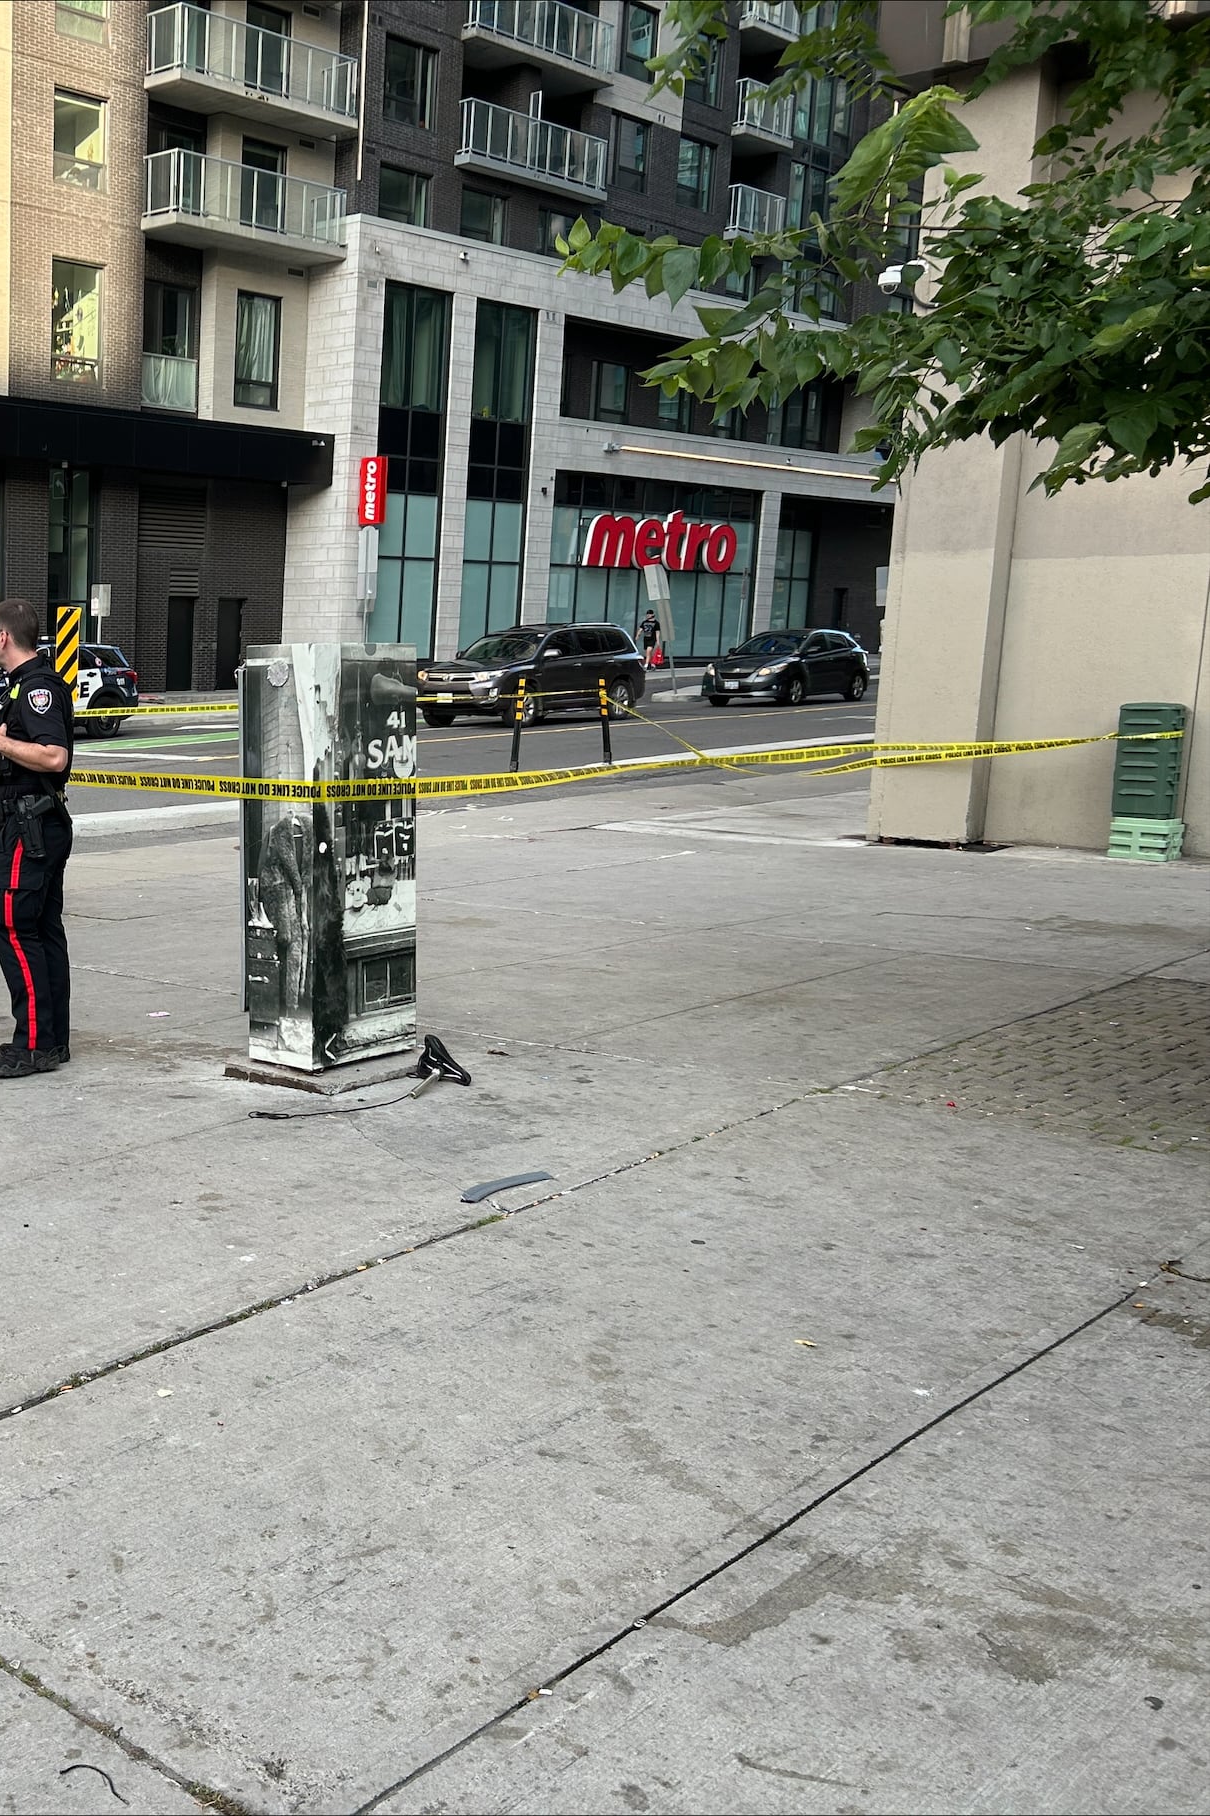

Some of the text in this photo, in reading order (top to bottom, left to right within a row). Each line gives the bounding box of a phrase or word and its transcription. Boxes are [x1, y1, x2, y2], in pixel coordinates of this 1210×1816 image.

[364, 460, 378, 521] metro
[582, 510, 738, 574] metro
[386, 710, 407, 729] 41
[139, 775, 159, 787] CROSS
[159, 776, 172, 788] NOT
[171, 777, 181, 789] DO
[219, 780, 321, 799] POLICE LINE DO NOT CROSS
[326, 782, 416, 799] POLICE LINE DO NOT CROSS
